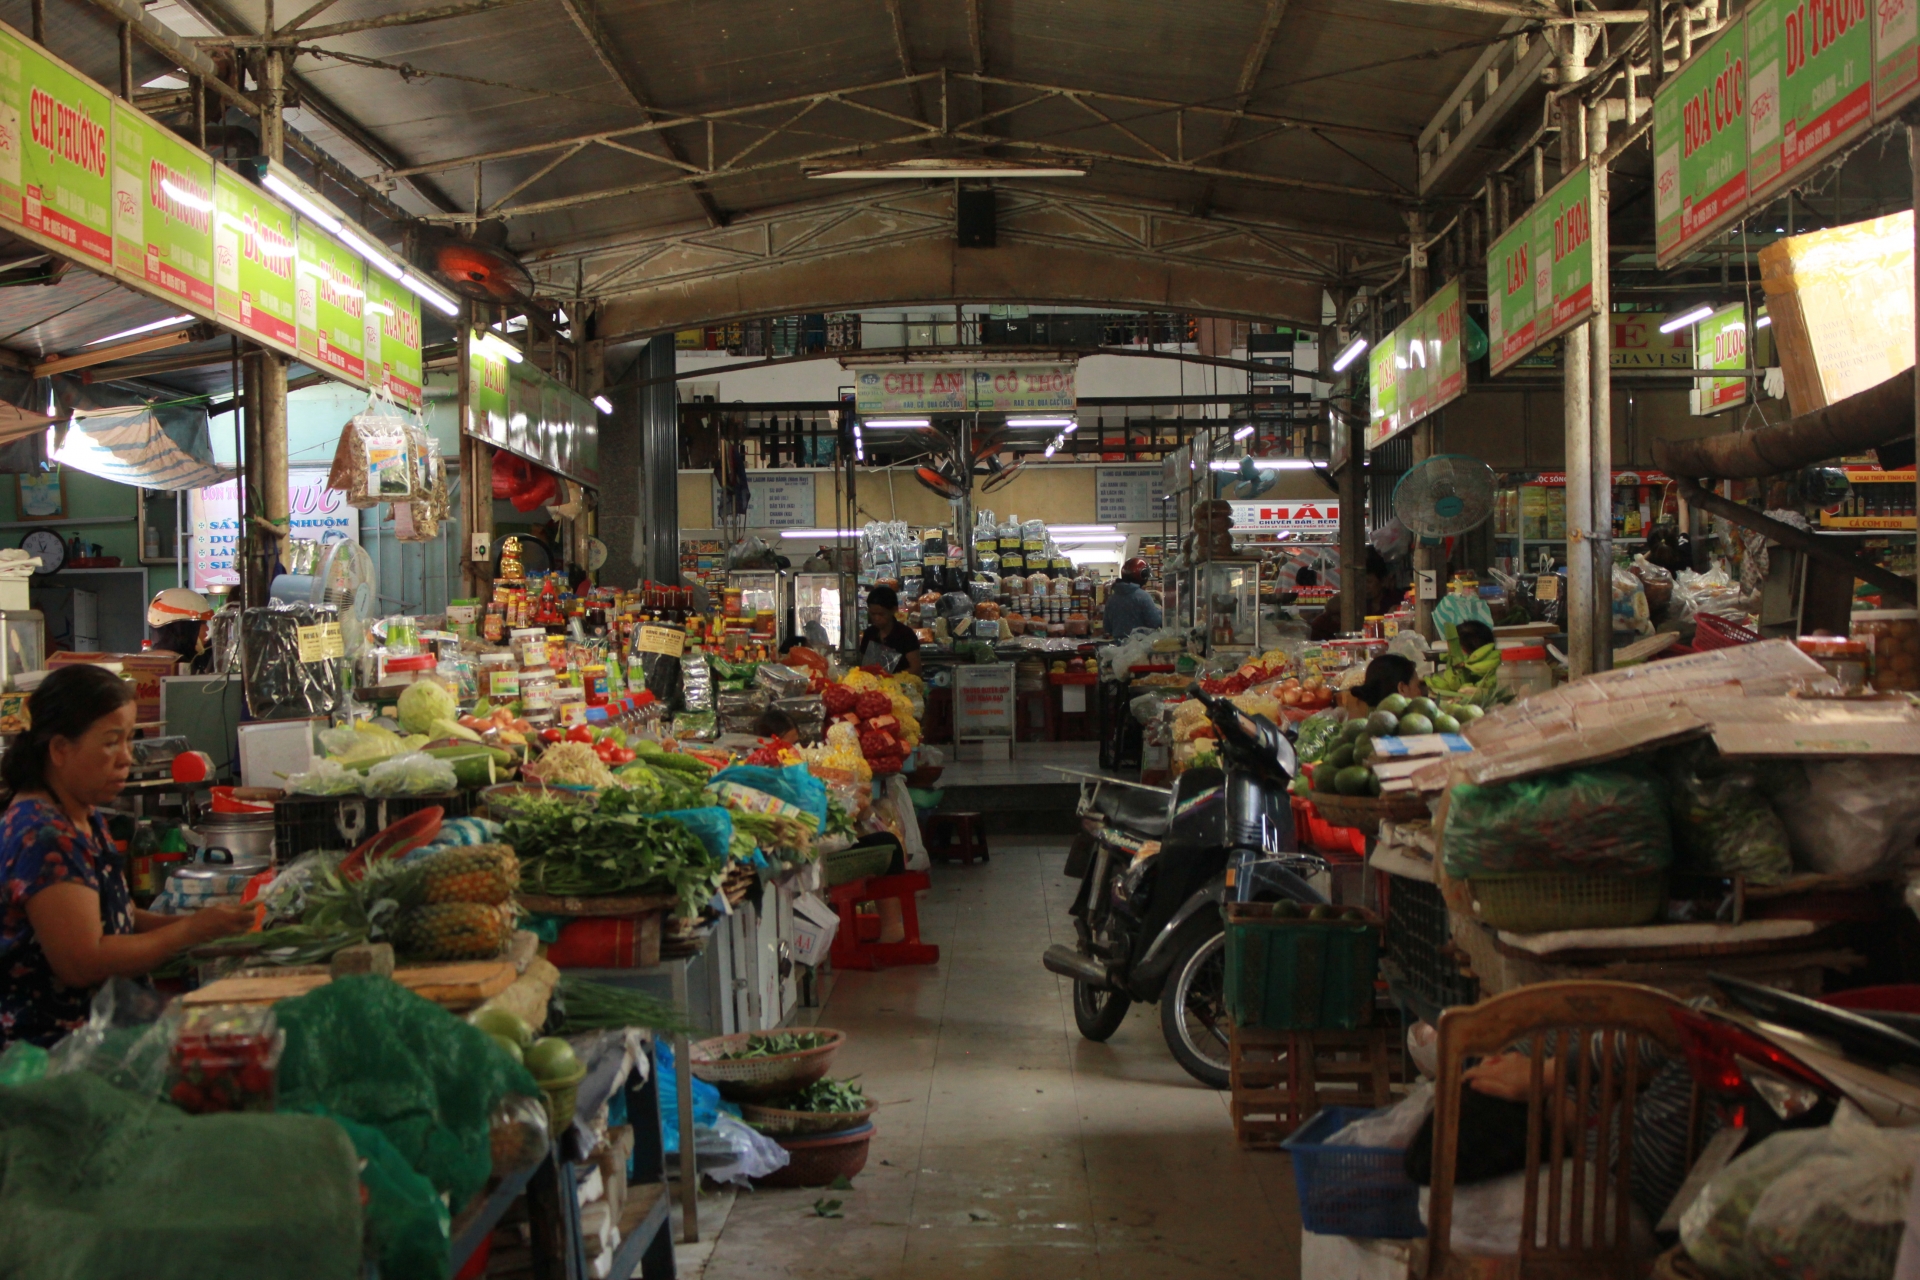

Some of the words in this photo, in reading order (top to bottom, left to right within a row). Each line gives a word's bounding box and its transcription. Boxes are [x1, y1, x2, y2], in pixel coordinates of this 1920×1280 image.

[1683, 86, 1712, 161] HOA
[1714, 50, 1743, 134] CÚC
[30, 87, 55, 165] CHỊ
[57, 100, 107, 179] PHƯƠNG
[1566, 195, 1590, 254] HOA
[1506, 241, 1528, 296] LAN
[1646, 352, 1665, 367] VỊ
[884, 372, 925, 399] CHỊ
[930, 372, 963, 393] AN
[994, 370, 1019, 393] CÔ
[290, 518, 349, 529] NHUỘM
[1260, 503, 1338, 520] HẢI
[1849, 518, 1860, 527] CÁ
